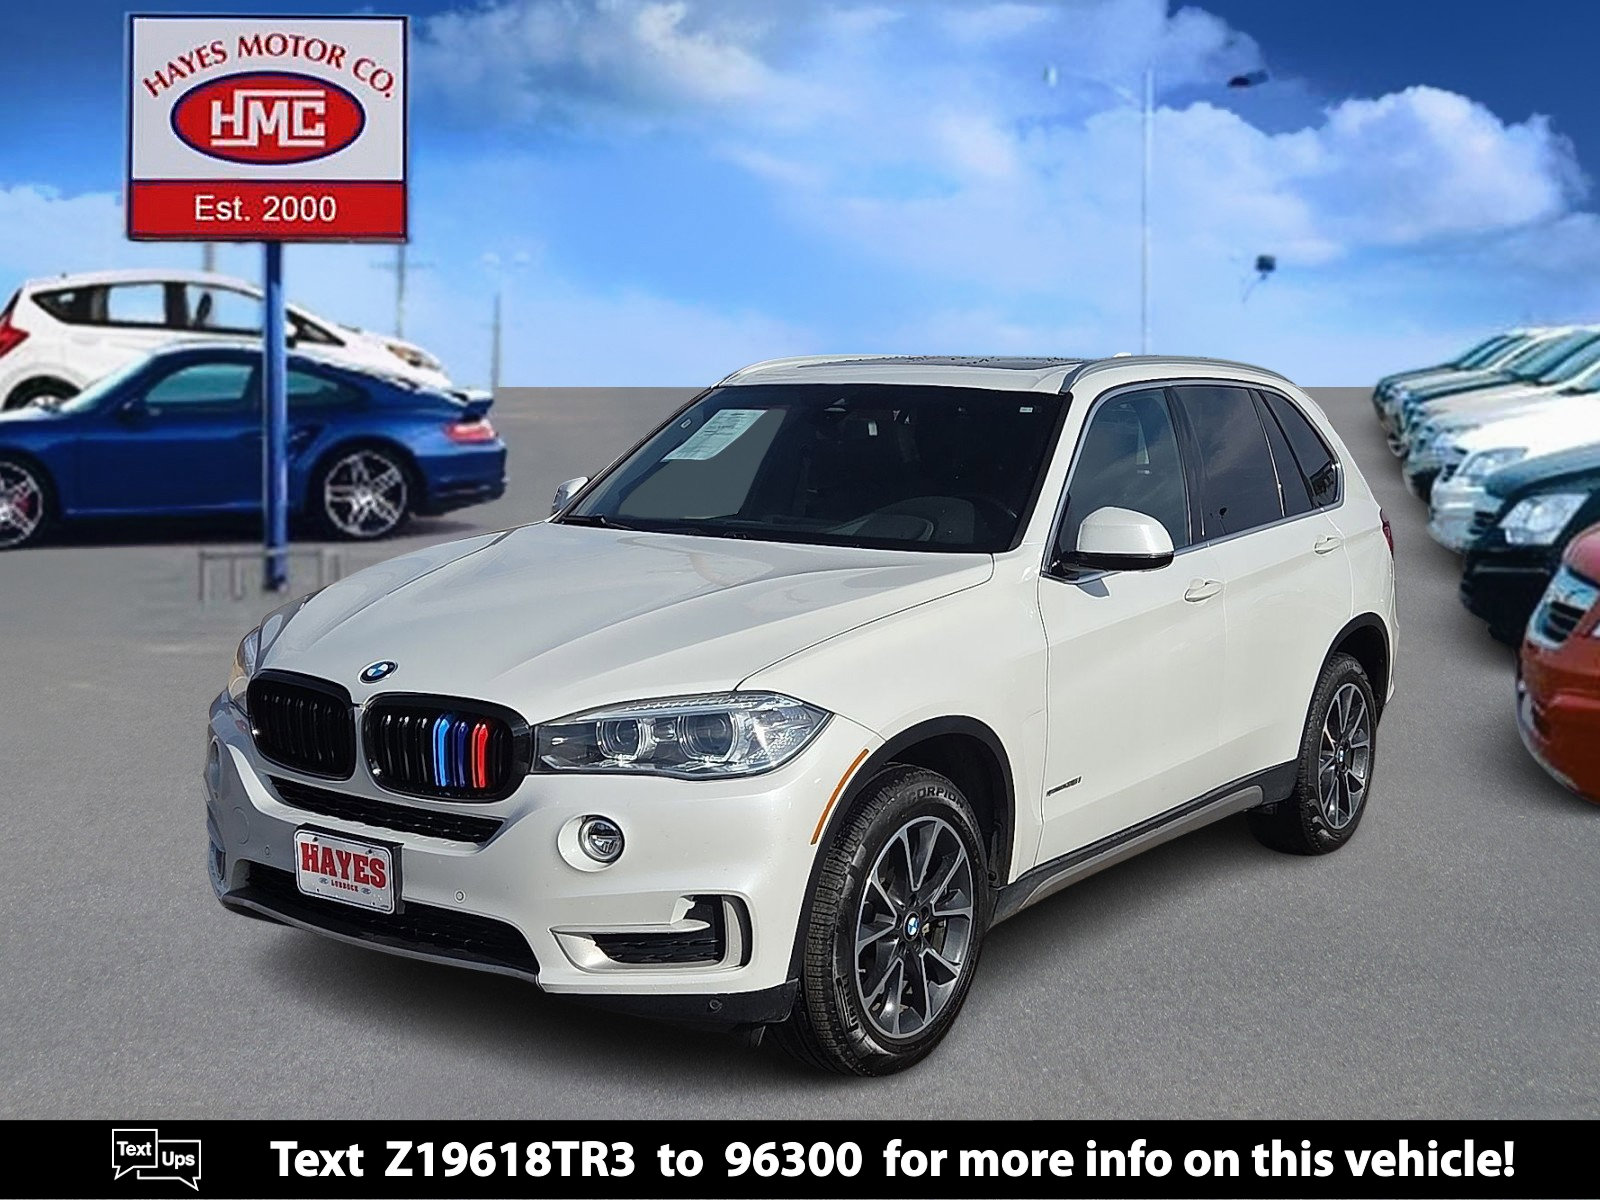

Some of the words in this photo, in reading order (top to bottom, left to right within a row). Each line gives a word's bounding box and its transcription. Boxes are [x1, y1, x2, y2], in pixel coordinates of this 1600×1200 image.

[143, 41, 228, 97] HAYES
[237, 33, 347, 69] MOTOR
[352, 57, 395, 98] CO.
[210, 89, 326, 147] HMC
[194, 194, 250, 221] Est.
[262, 195, 337, 222] 2000
[300, 841, 387, 889] HAYES
